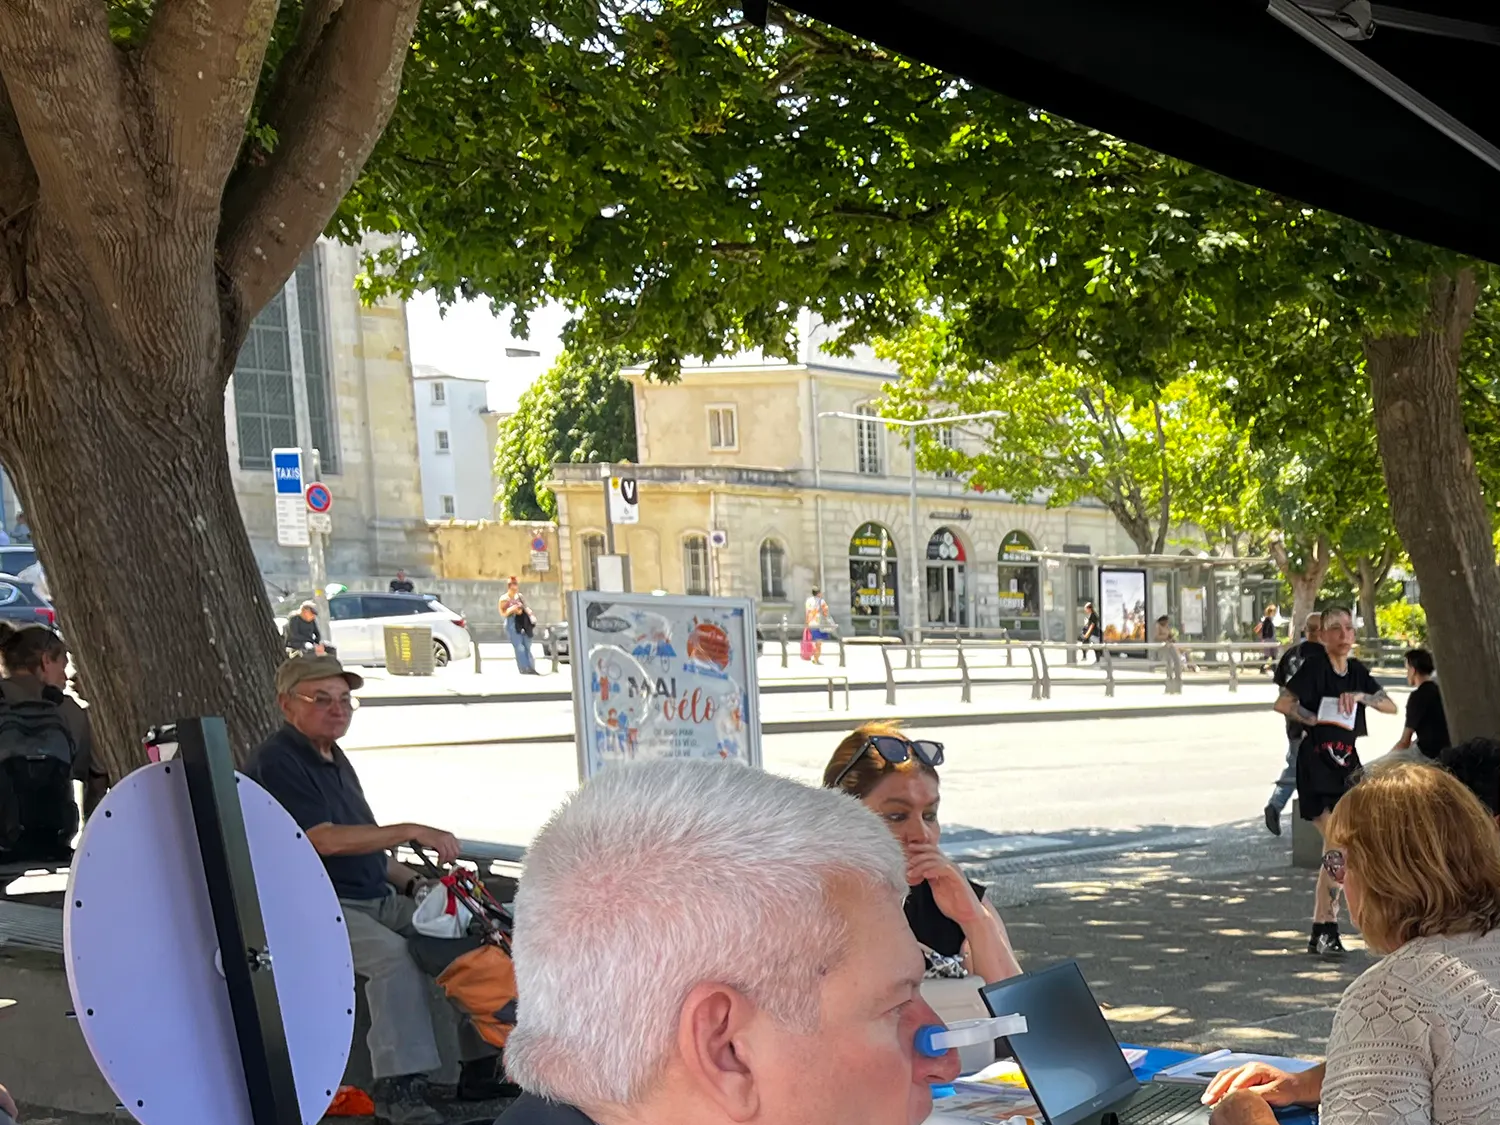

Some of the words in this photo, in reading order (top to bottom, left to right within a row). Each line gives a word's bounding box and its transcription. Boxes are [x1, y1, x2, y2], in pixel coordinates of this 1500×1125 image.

[275, 467, 301, 481] TAXIS
[627, 676, 677, 699] MAI
[663, 687, 720, 724] vélo
